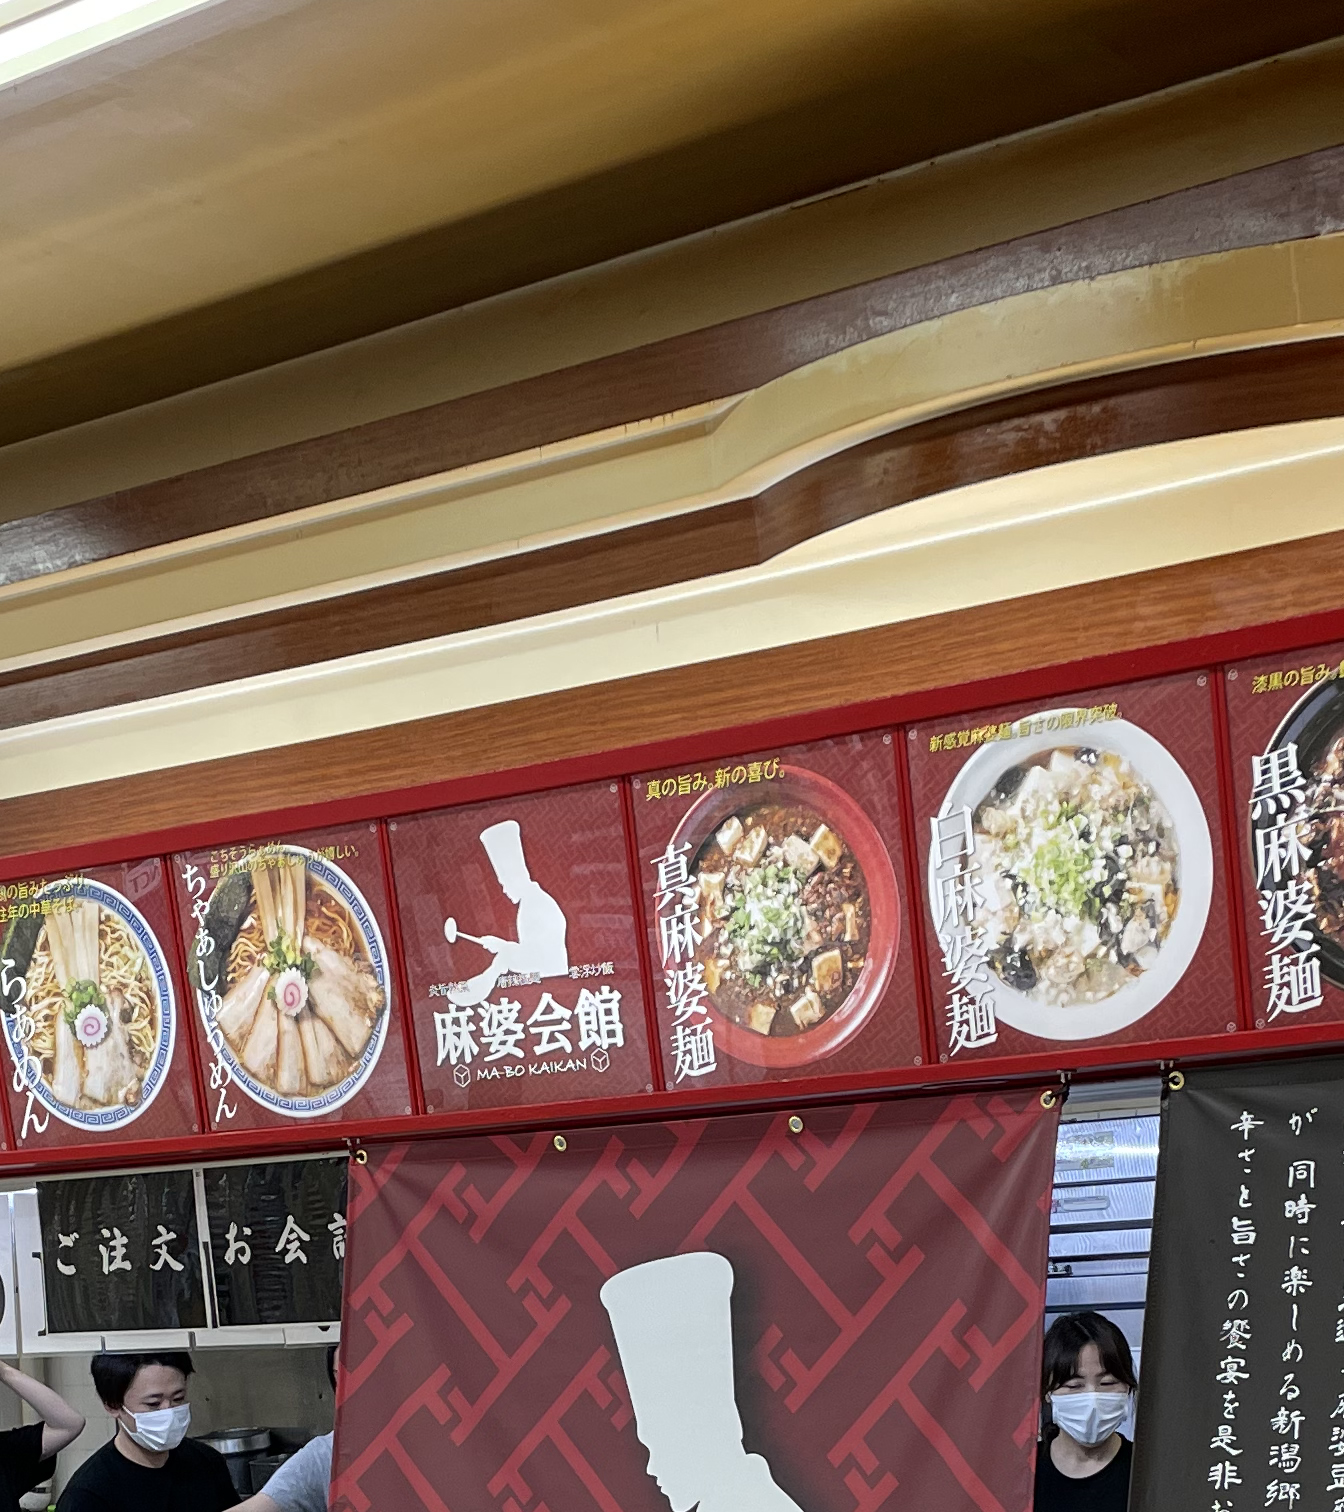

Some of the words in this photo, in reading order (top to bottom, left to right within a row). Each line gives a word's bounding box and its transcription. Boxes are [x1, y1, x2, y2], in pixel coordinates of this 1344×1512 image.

[646, 758, 785, 801] 真の旨み。新の喜び。
[1248, 741, 1324, 1022] 黒麻婆麺
[649, 841, 717, 1084] 真麻婆麺
[929, 802, 998, 1056] 白麻婆麺
[433, 986, 624, 1067] 麻婆会館
[477, 1065, 525, 1081] MA-BO
[528, 1058, 587, 1076] KAIKAN
[56, 1223, 185, 1277] ご注文
